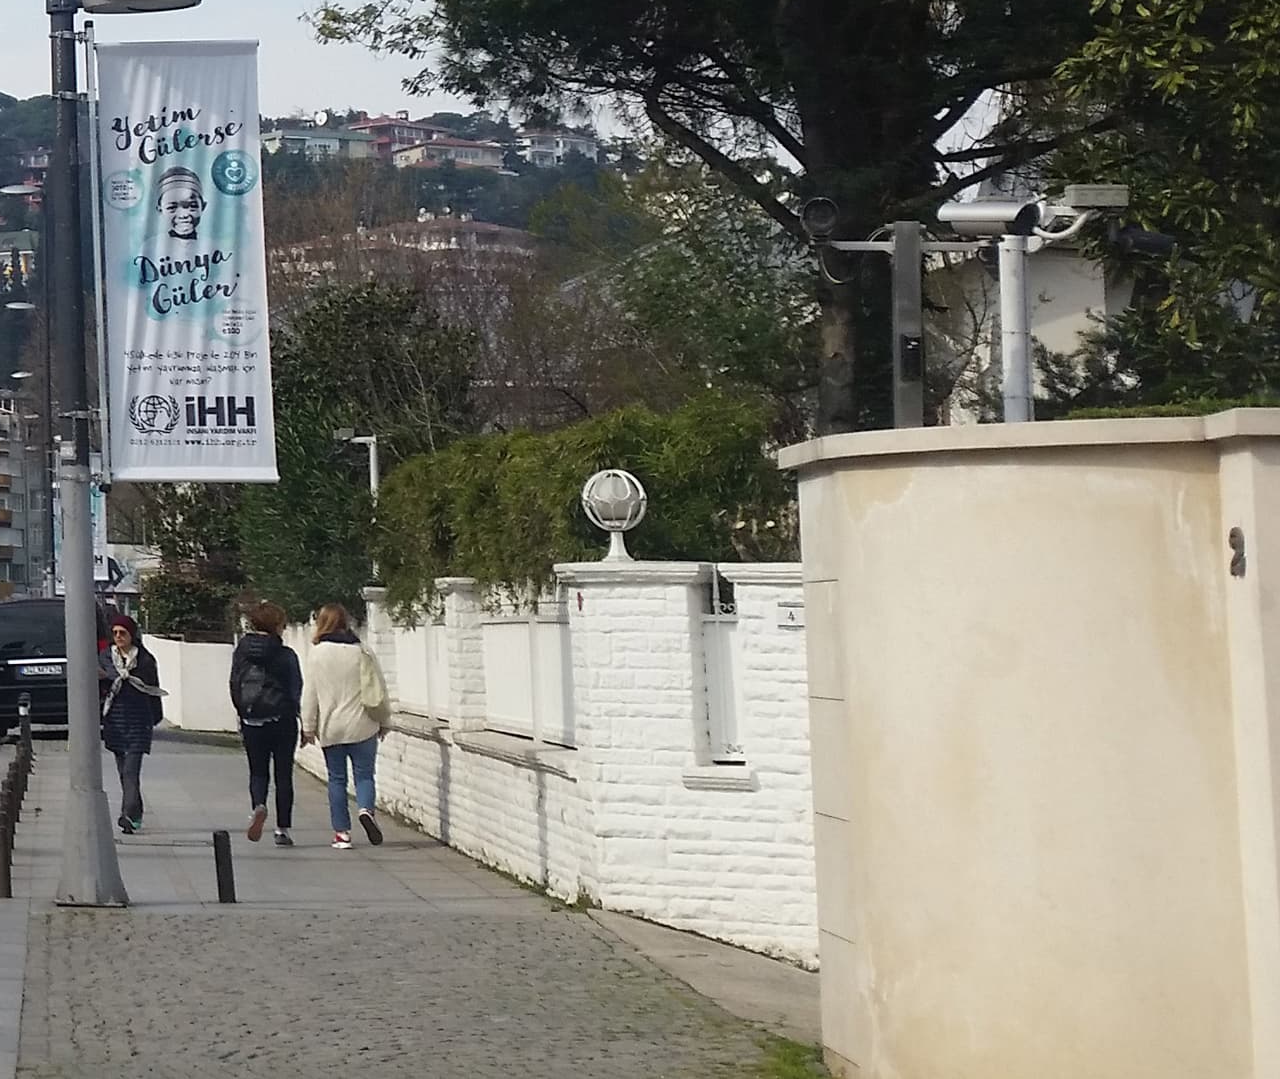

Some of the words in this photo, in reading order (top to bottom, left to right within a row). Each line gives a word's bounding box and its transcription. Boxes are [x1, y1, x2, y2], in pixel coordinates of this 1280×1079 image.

[139, 121, 242, 164] Gülerse
[133, 249, 232, 286] Dünya
[152, 278, 238, 314] Güler
